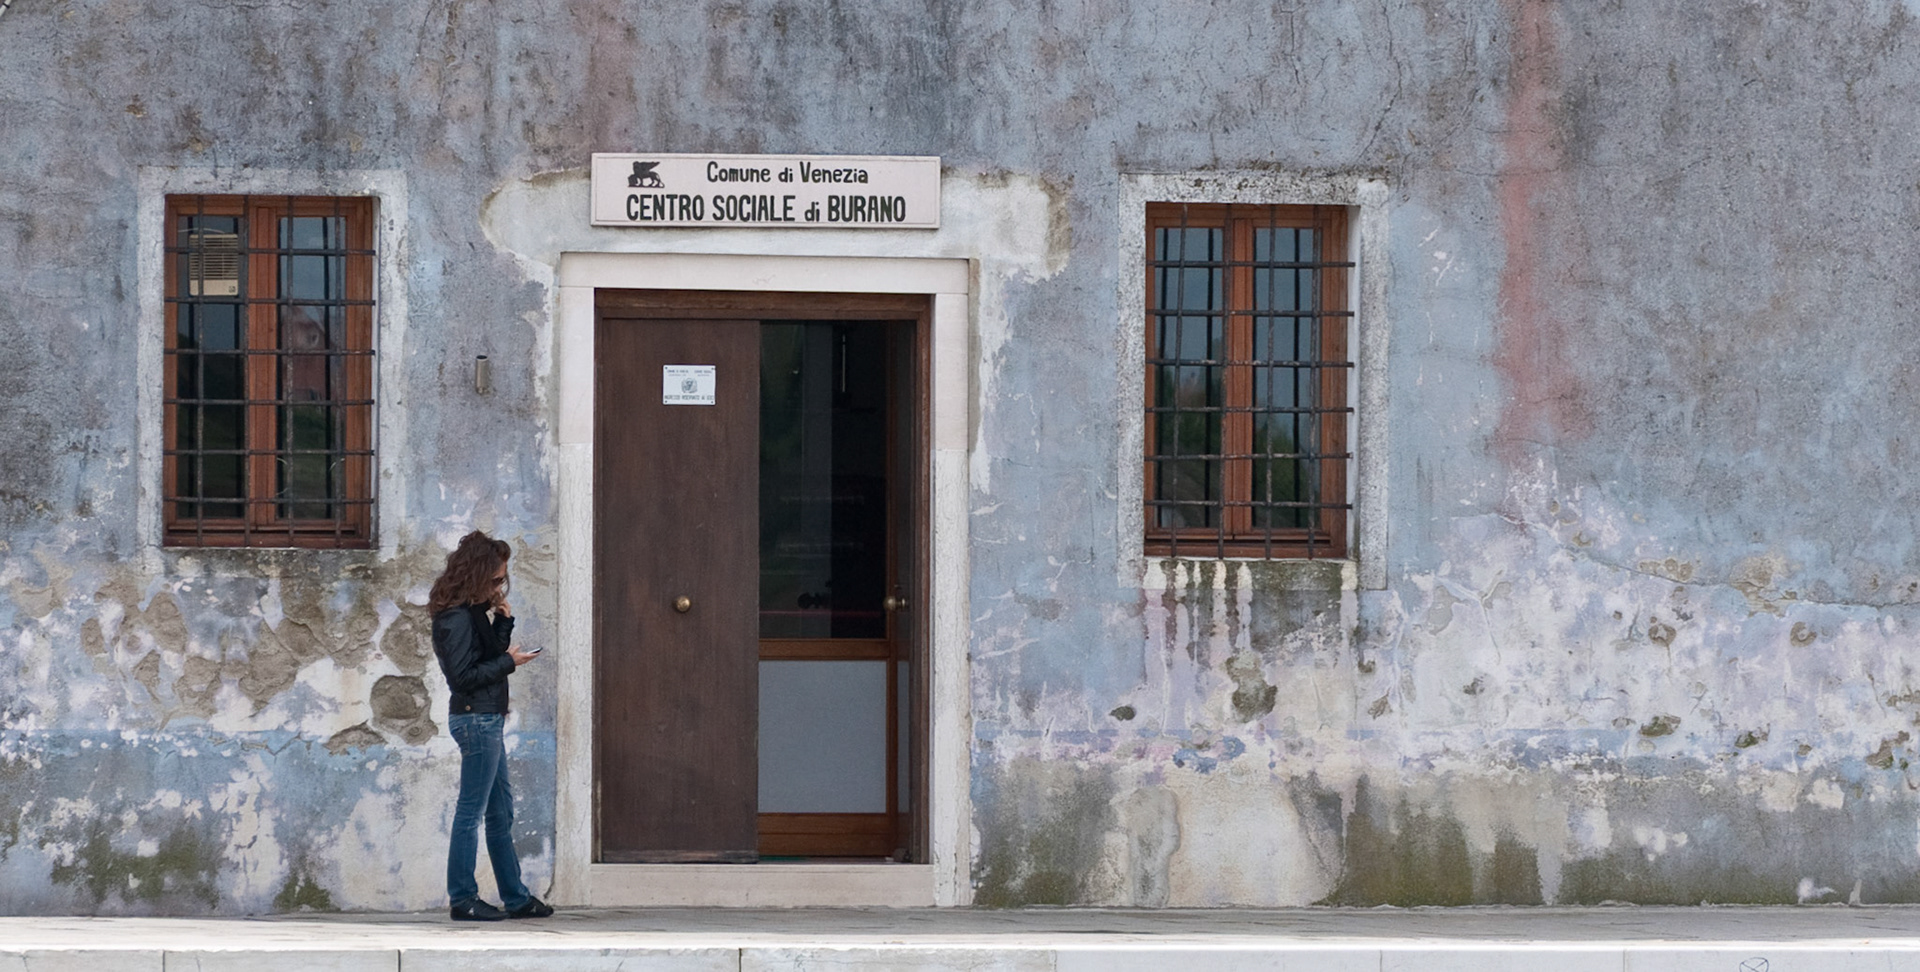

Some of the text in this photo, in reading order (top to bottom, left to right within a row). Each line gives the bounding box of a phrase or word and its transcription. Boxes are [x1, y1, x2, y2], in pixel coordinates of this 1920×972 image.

[706, 160, 869, 184] Comune di Venezia
[626, 193, 906, 223] CENTRO SOCIALE di BURANO
